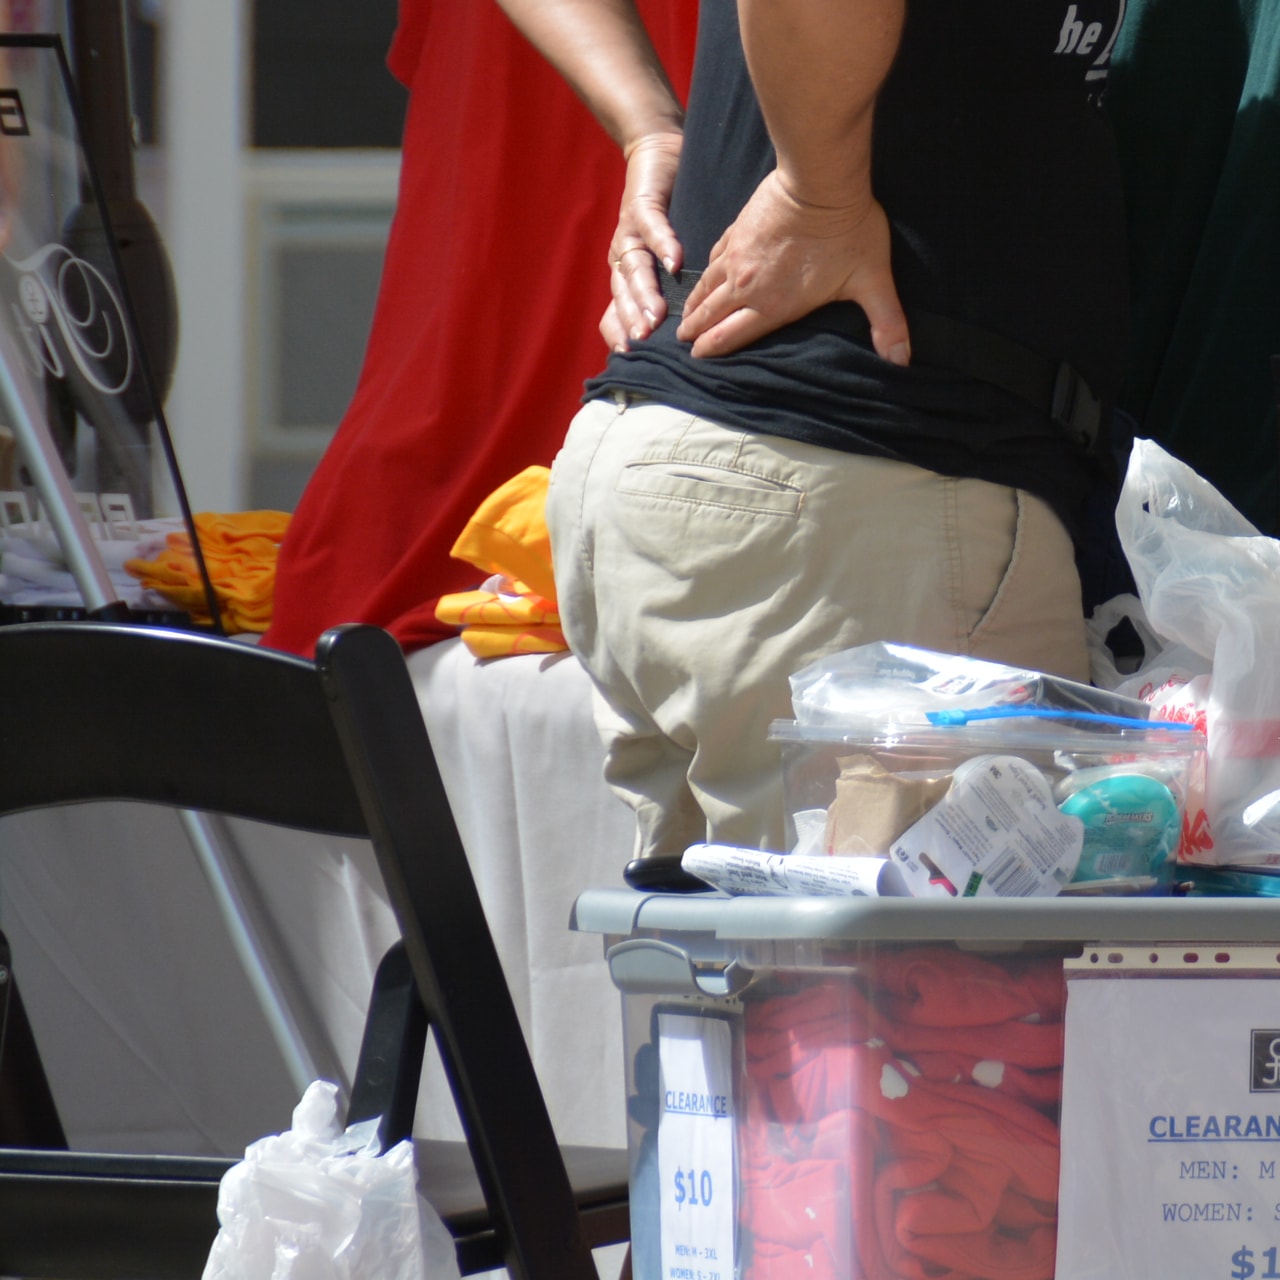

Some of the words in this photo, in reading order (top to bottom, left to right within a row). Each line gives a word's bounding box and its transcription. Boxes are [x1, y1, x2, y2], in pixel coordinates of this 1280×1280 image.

[665, 1091, 727, 1114] CLEARANCE
[1179, 1161, 1239, 1180] MEN:
[1258, 1161, 1275, 1179] M
[674, 1165, 713, 1211] $10
[1162, 1203, 1253, 1222] WOMEN:
